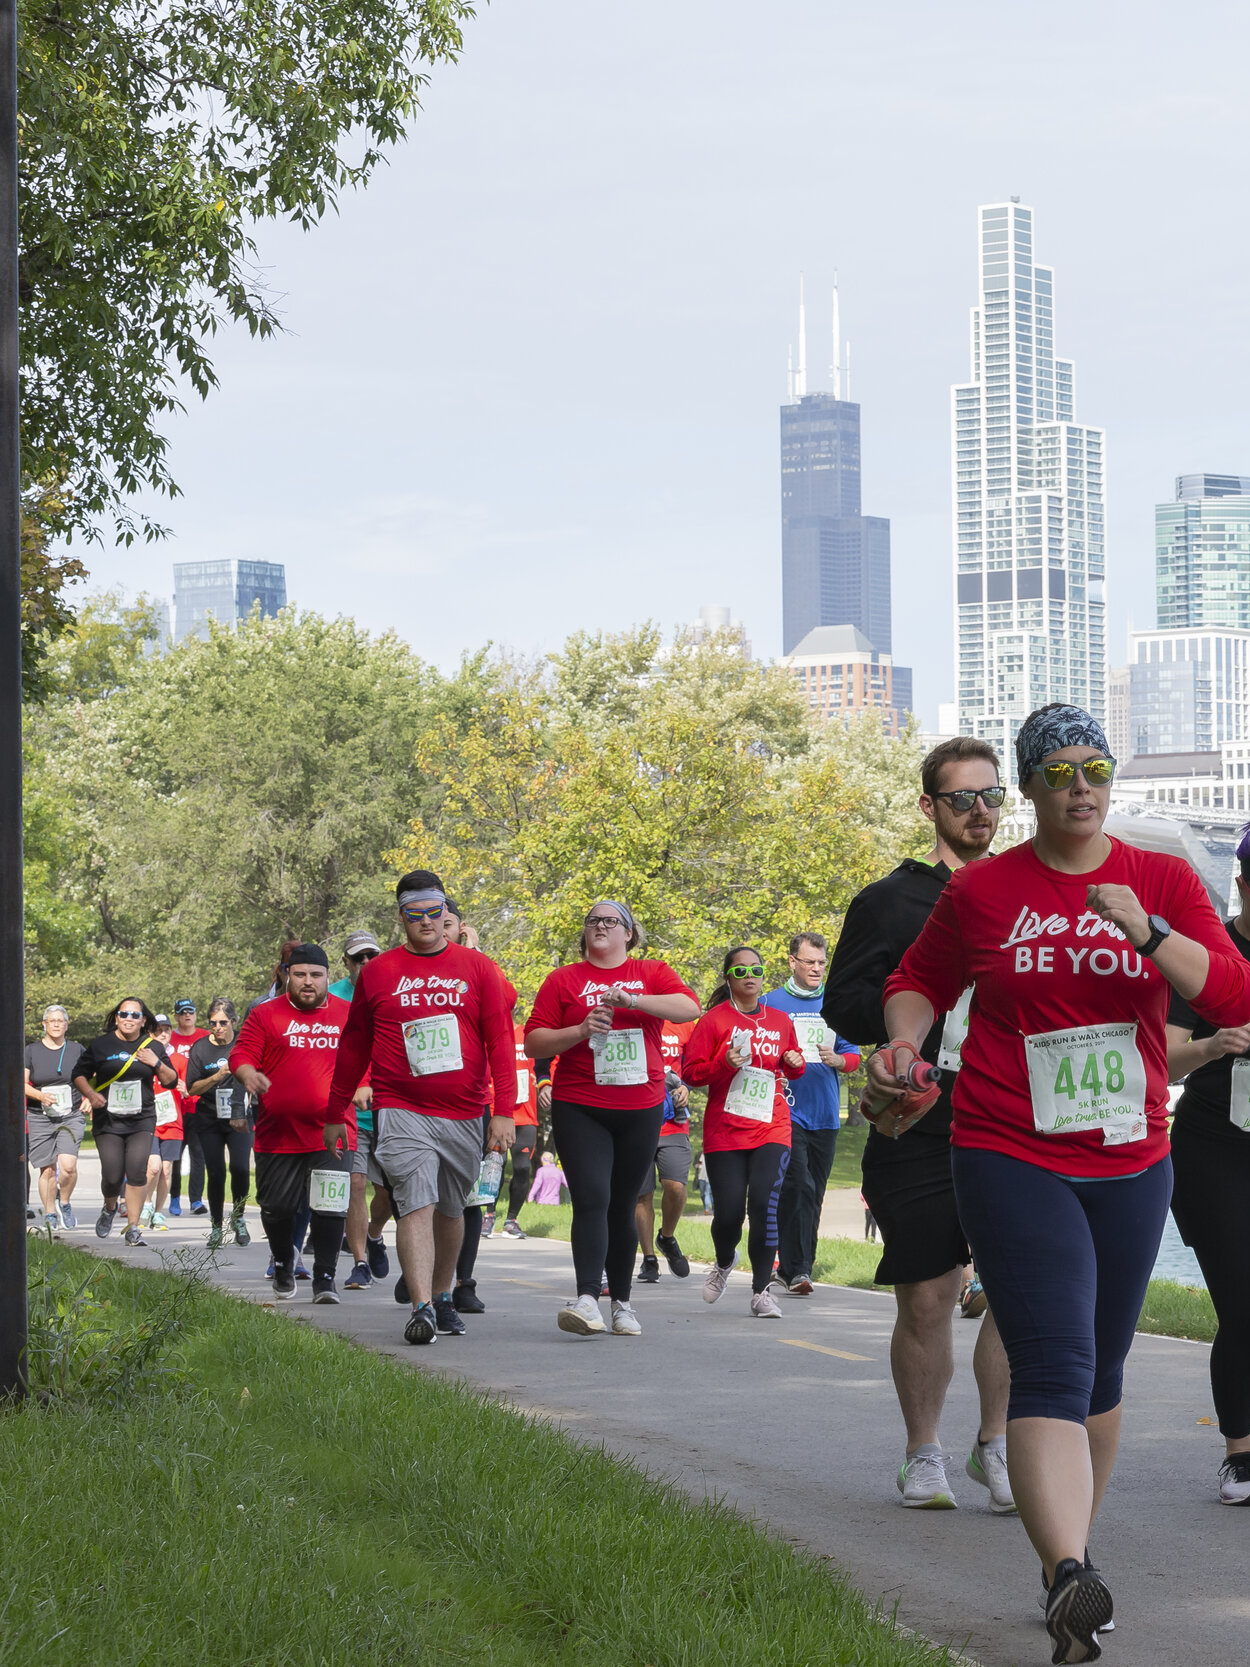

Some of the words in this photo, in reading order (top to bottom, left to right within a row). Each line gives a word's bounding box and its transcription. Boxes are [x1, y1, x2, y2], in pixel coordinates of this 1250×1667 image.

[1000, 905, 1070, 949] Live
[1076, 910, 1127, 941] tru
[1015, 946, 1055, 973] BE
[1065, 947, 1149, 979] YOU.
[391, 975, 425, 996] Live
[578, 980, 609, 997] Live
[400, 993, 420, 1007] BE
[423, 992, 465, 1007] YOU.
[586, 994, 604, 1007] BE
[282, 1019, 311, 1036] Live
[807, 1027, 824, 1044] 28
[289, 1035, 305, 1048] BE
[415, 1027, 450, 1051] 379
[1033, 1041, 1051, 1049] AIDS
[1052, 1037, 1069, 1046] RUN
[1078, 1032, 1101, 1041] WALK
[1101, 1029, 1129, 1038] CHICAGO
[605, 1041, 637, 1062] 380
[661, 1046, 680, 1057] OU.
[1054, 1050, 1125, 1100] 448
[115, 1088, 134, 1101] 147
[741, 1077, 768, 1099] 139
[156, 1099, 169, 1112] 08
[1078, 1100, 1089, 1109] 5K
[1091, 1098, 1109, 1108] RUN
[1051, 1115, 1073, 1131] Live
[1098, 1109, 1111, 1119] BE
[1112, 1104, 1134, 1115] YOU.
[320, 1181, 346, 1200] 164
